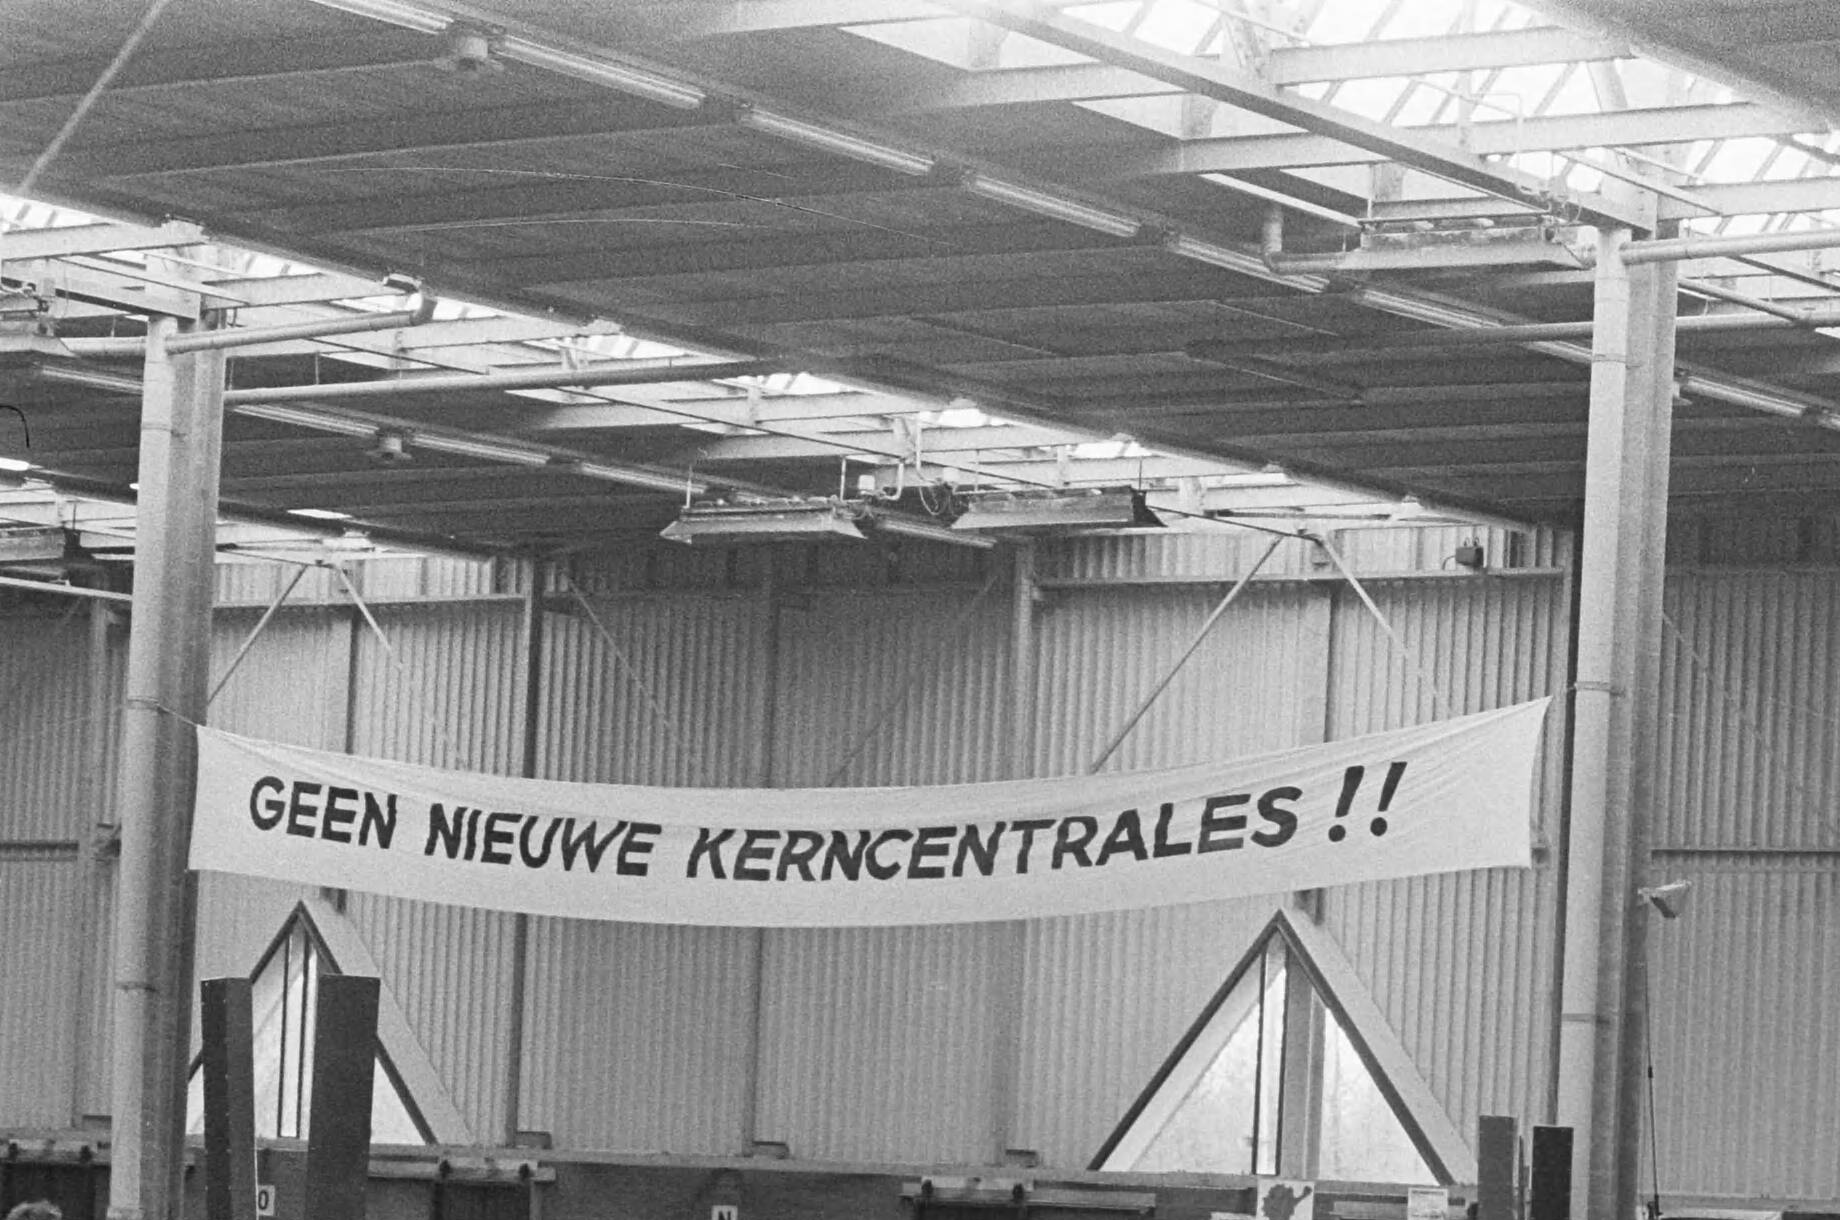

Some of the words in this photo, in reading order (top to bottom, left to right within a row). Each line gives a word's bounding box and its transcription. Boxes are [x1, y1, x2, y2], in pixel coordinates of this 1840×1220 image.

[249, 775, 398, 850] GEEN
[424, 803, 662, 876] NIEUWE
[686, 786, 1303, 881] KERNCENTRALES
[1328, 761, 1408, 842] !!
